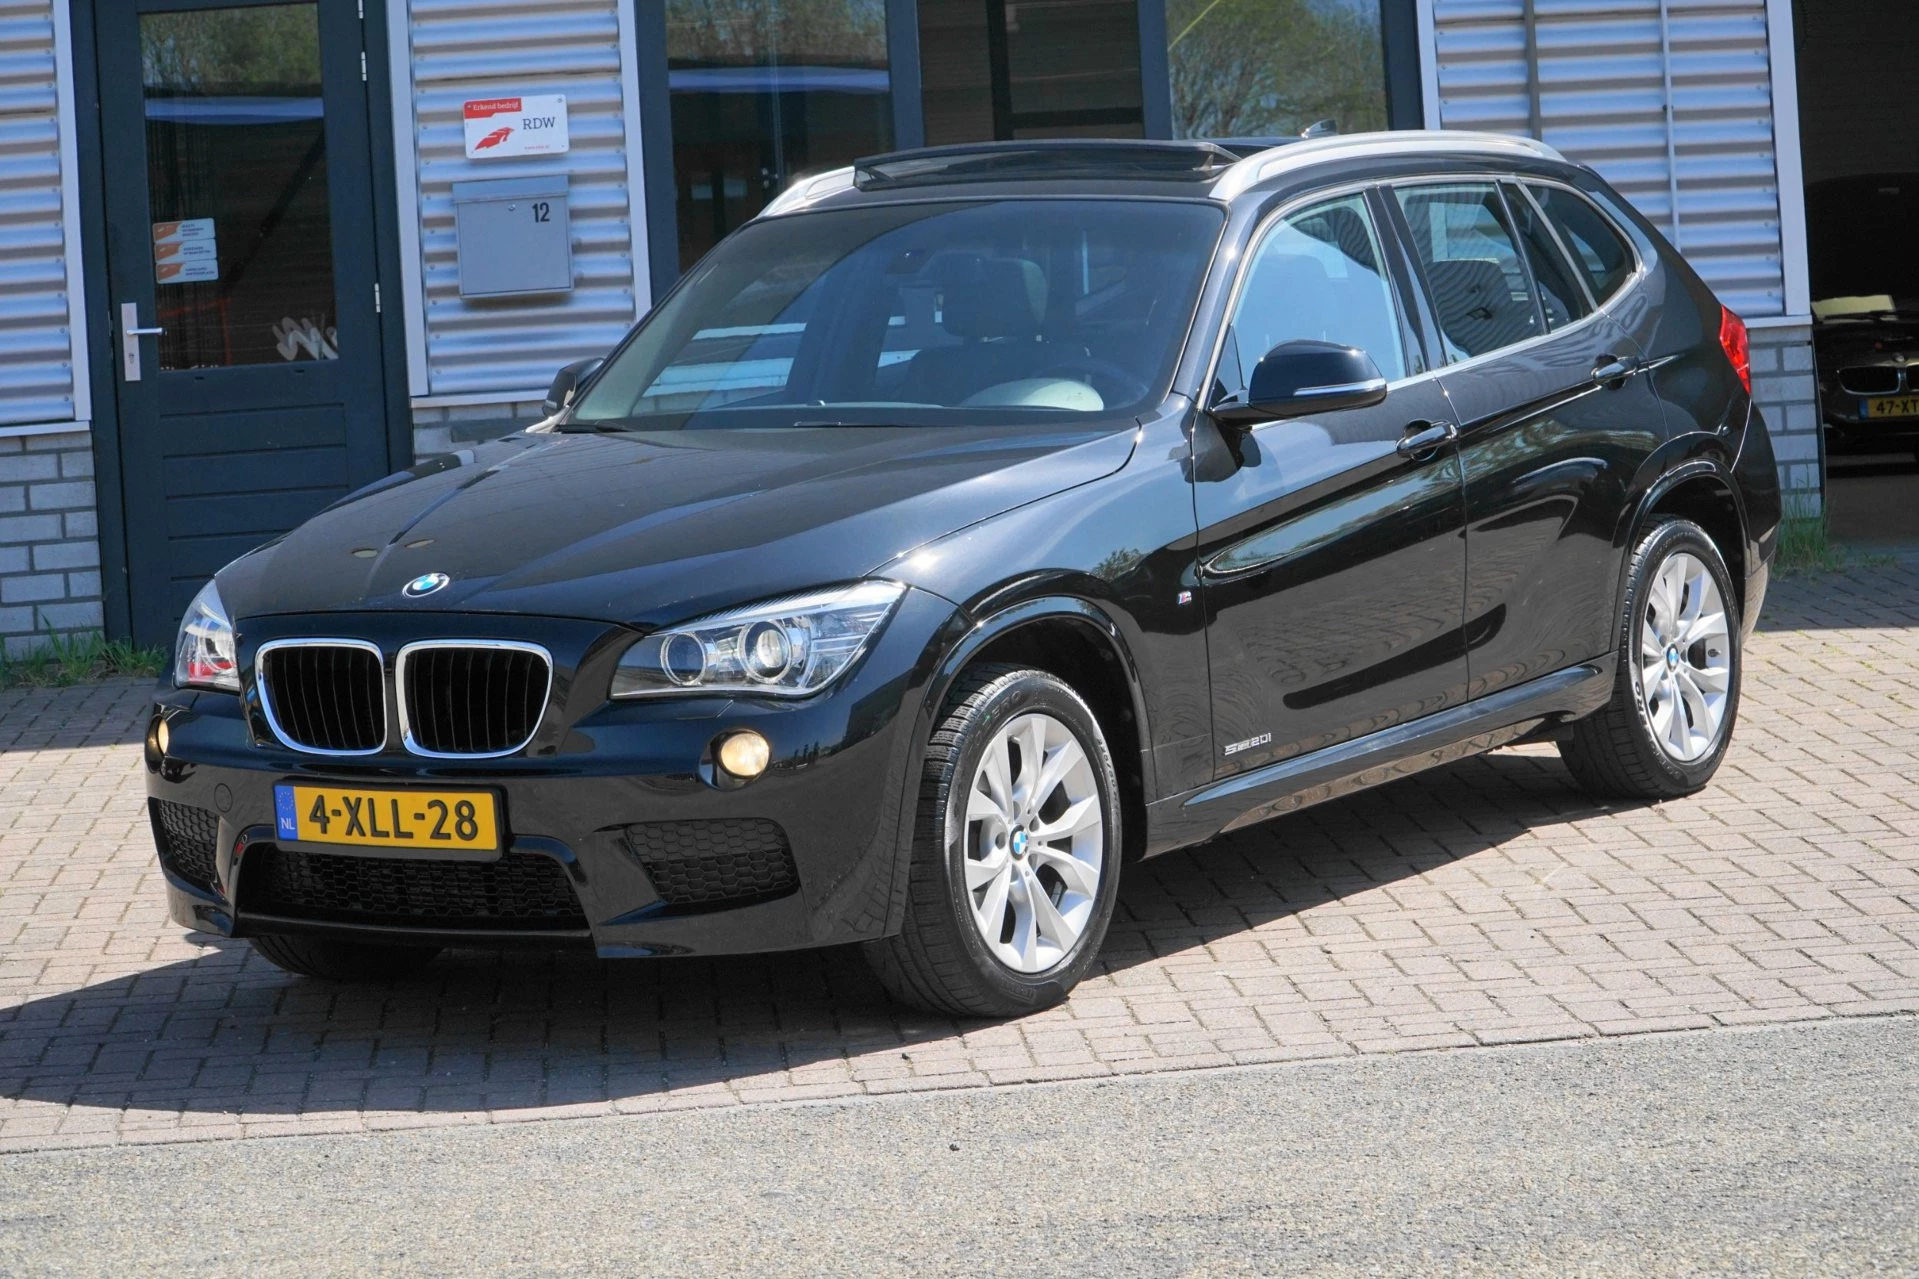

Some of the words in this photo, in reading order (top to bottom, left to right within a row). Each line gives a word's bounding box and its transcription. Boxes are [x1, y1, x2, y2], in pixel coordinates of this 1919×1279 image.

[473, 102, 496, 111] Erkend
[522, 116, 556, 130] RDW
[532, 202, 550, 223] 12
[281, 817, 296, 830] NL
[309, 794, 479, 841] 4-XLL-28
